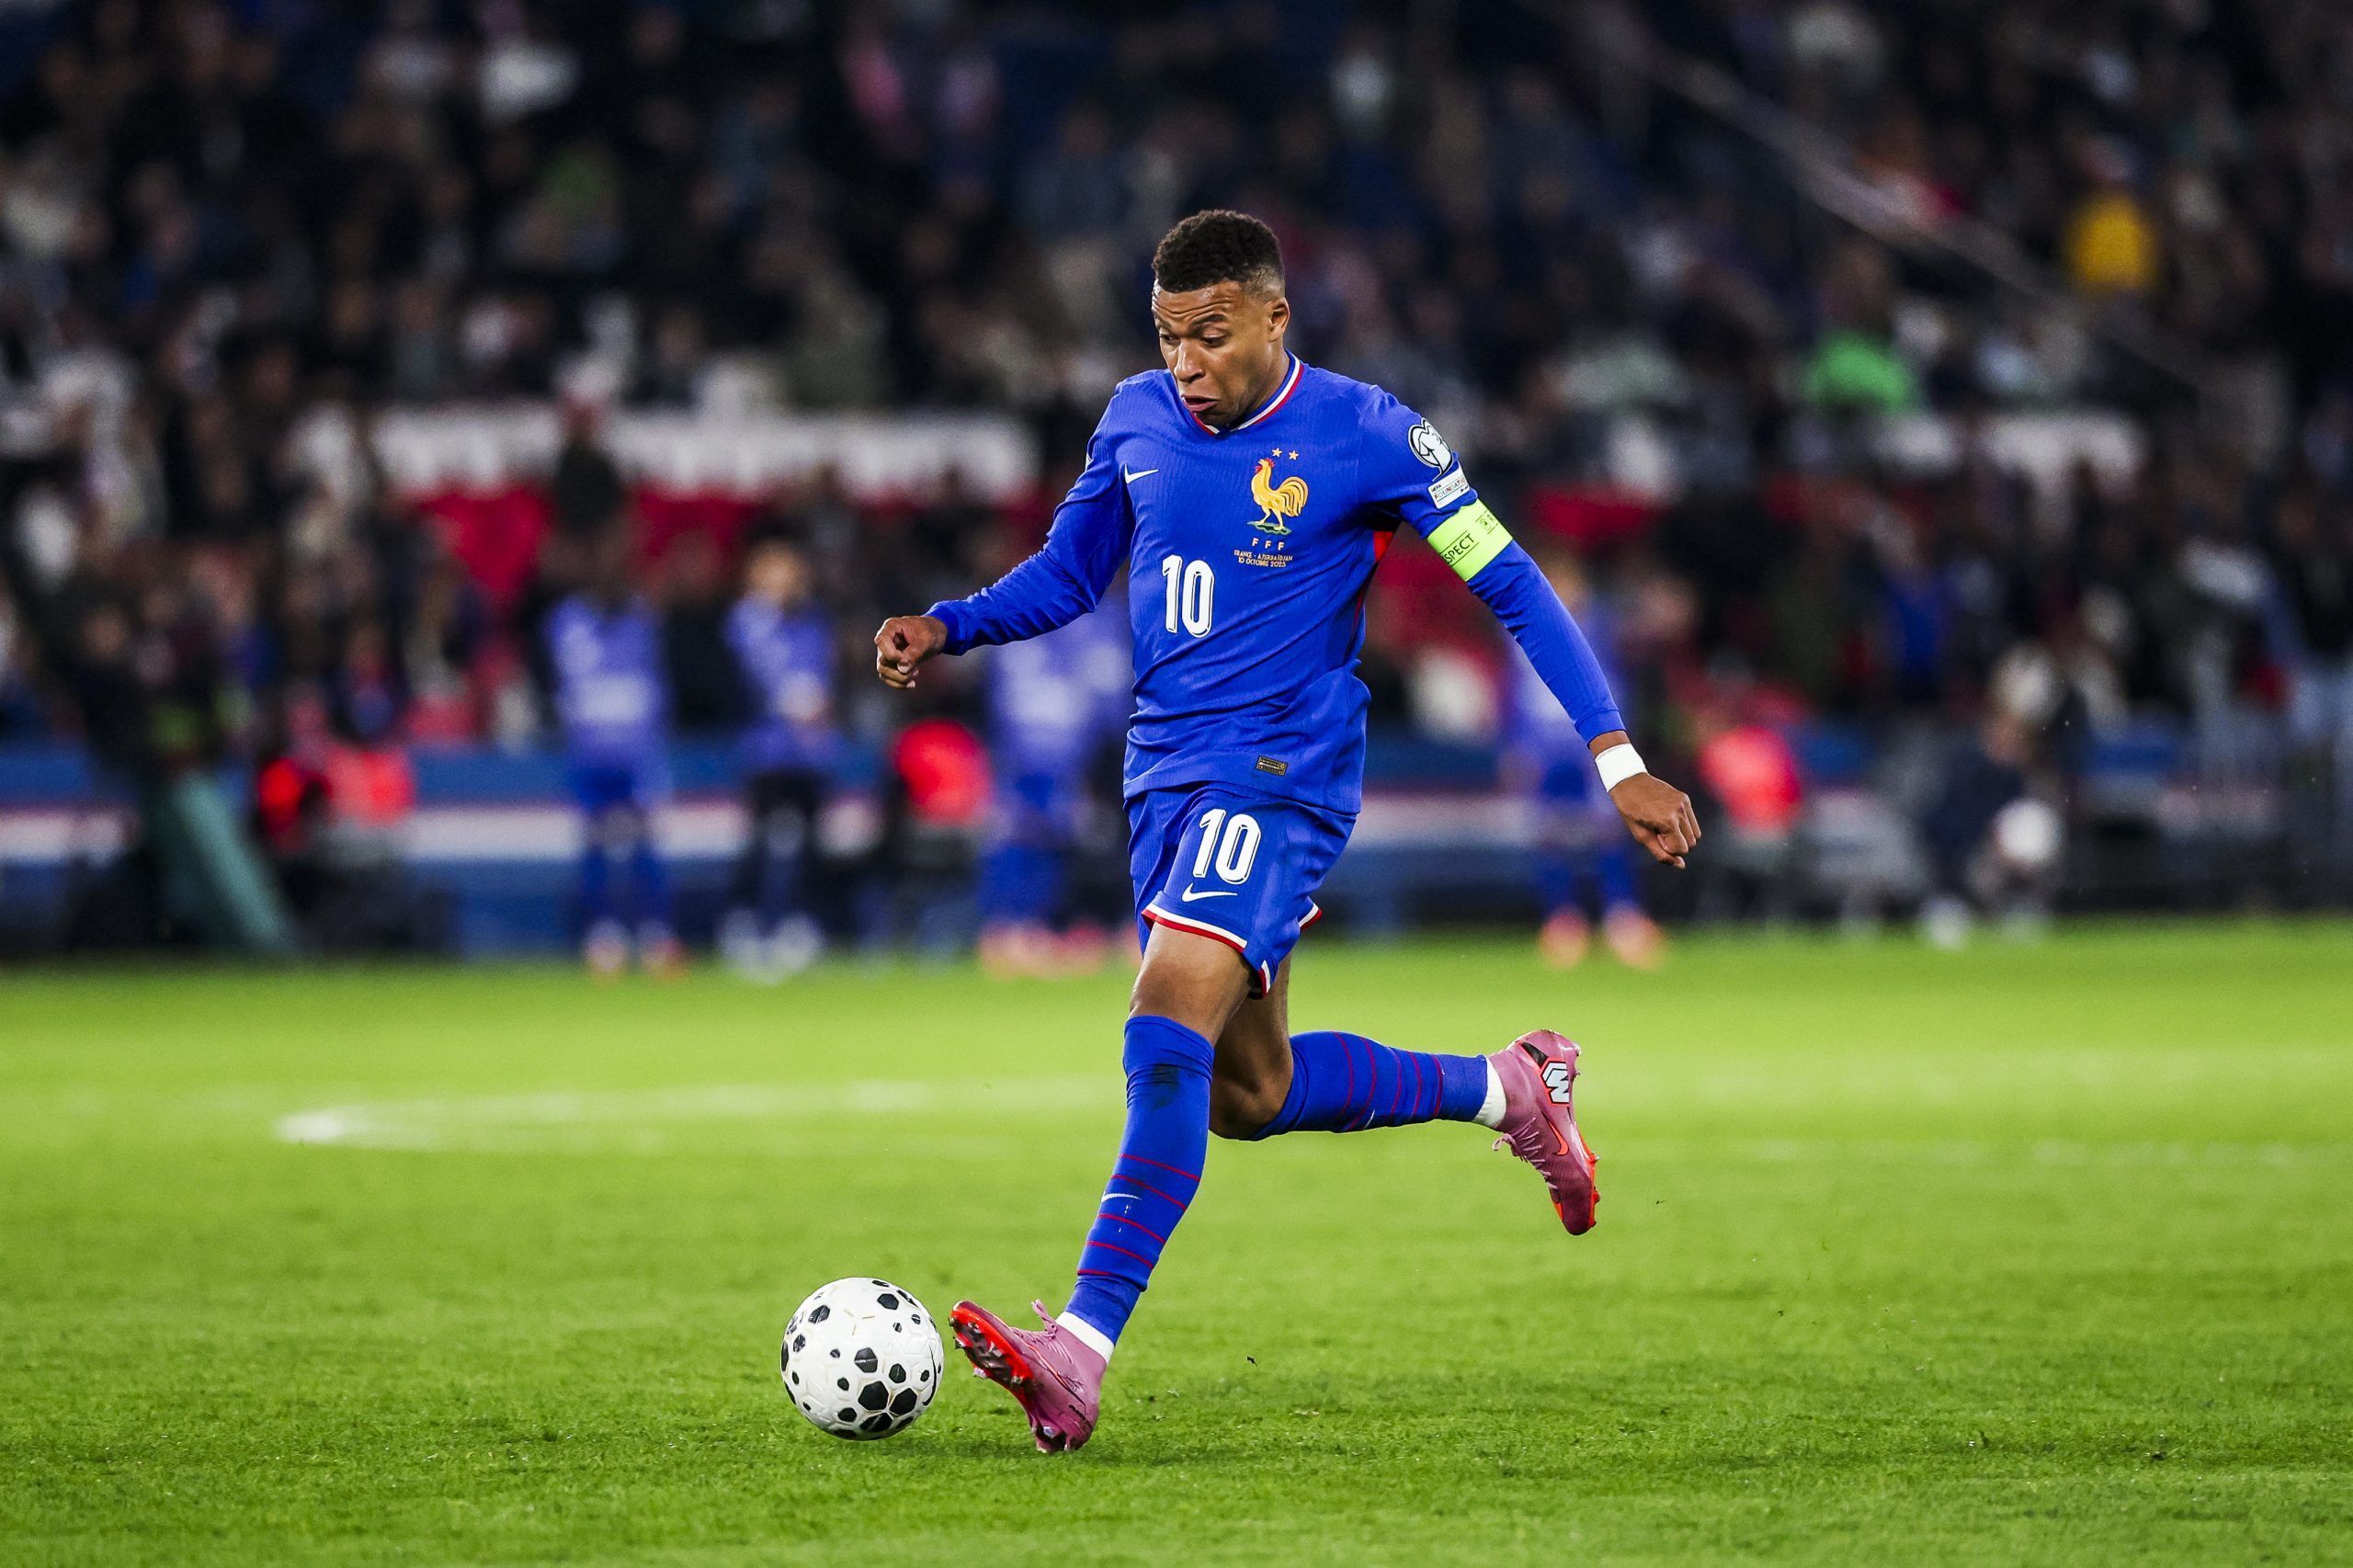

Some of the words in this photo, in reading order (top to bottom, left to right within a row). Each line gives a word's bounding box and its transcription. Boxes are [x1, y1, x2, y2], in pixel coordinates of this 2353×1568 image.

[1233, 550, 1252, 559] FRANCE
[1441, 533, 1474, 564] SPECT
[1162, 554, 1215, 638] 10
[1192, 808, 1262, 885] 10
